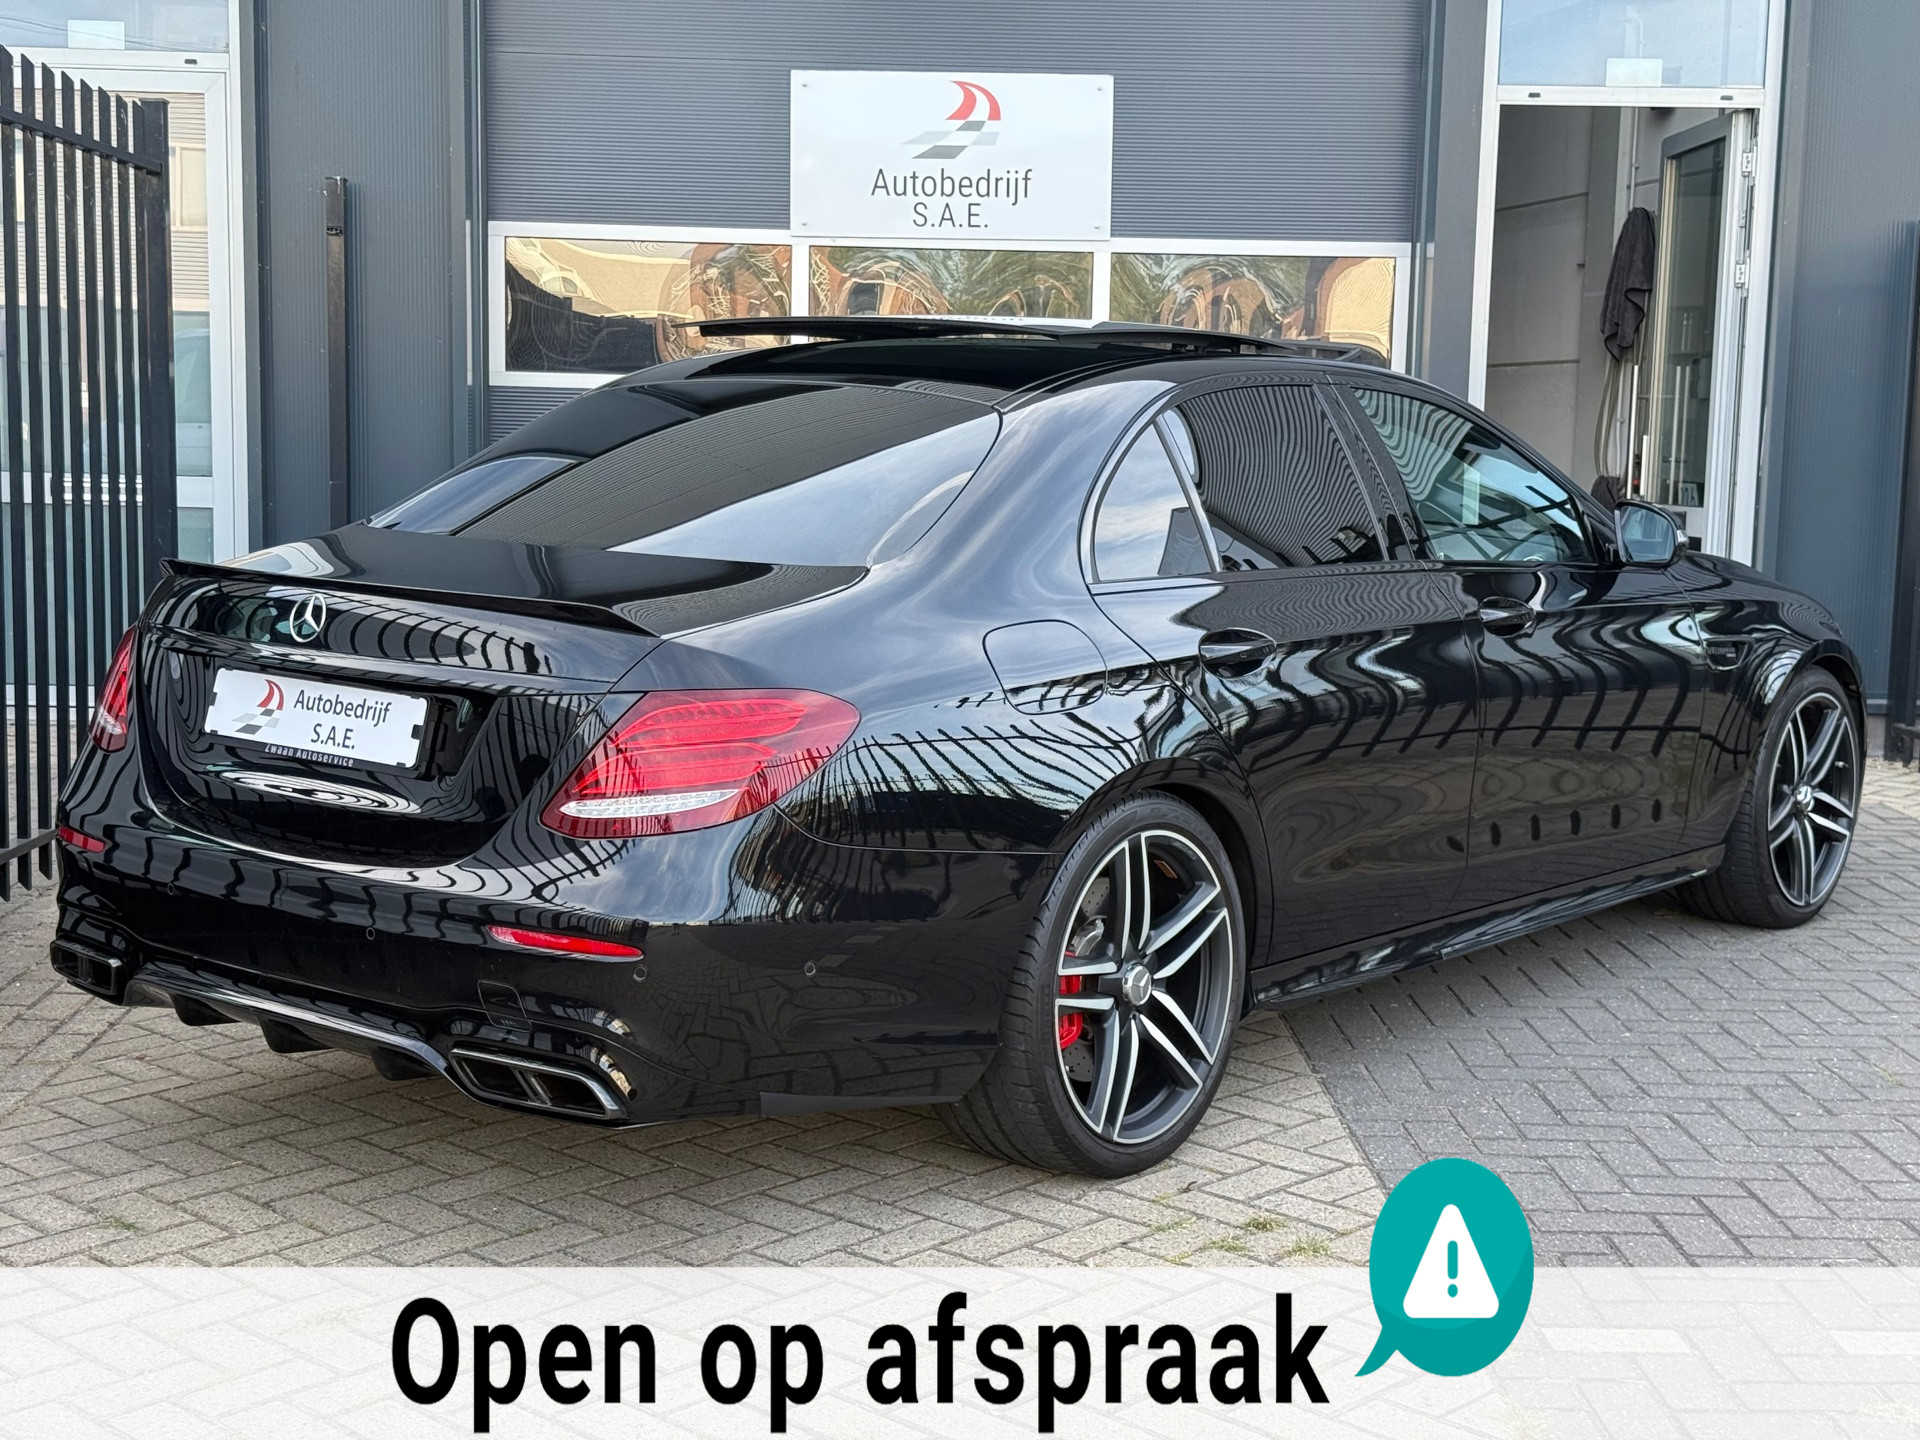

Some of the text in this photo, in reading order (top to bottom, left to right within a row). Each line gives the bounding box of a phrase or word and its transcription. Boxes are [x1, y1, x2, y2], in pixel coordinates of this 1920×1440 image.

[870, 167, 1033, 206] Autobedrijf
[912, 202, 989, 228] S.A.E.
[293, 689, 392, 727] Autobedrijf
[310, 723, 355, 750] S.A.E.
[264, 744, 354, 767] Zwaan Autoservice
